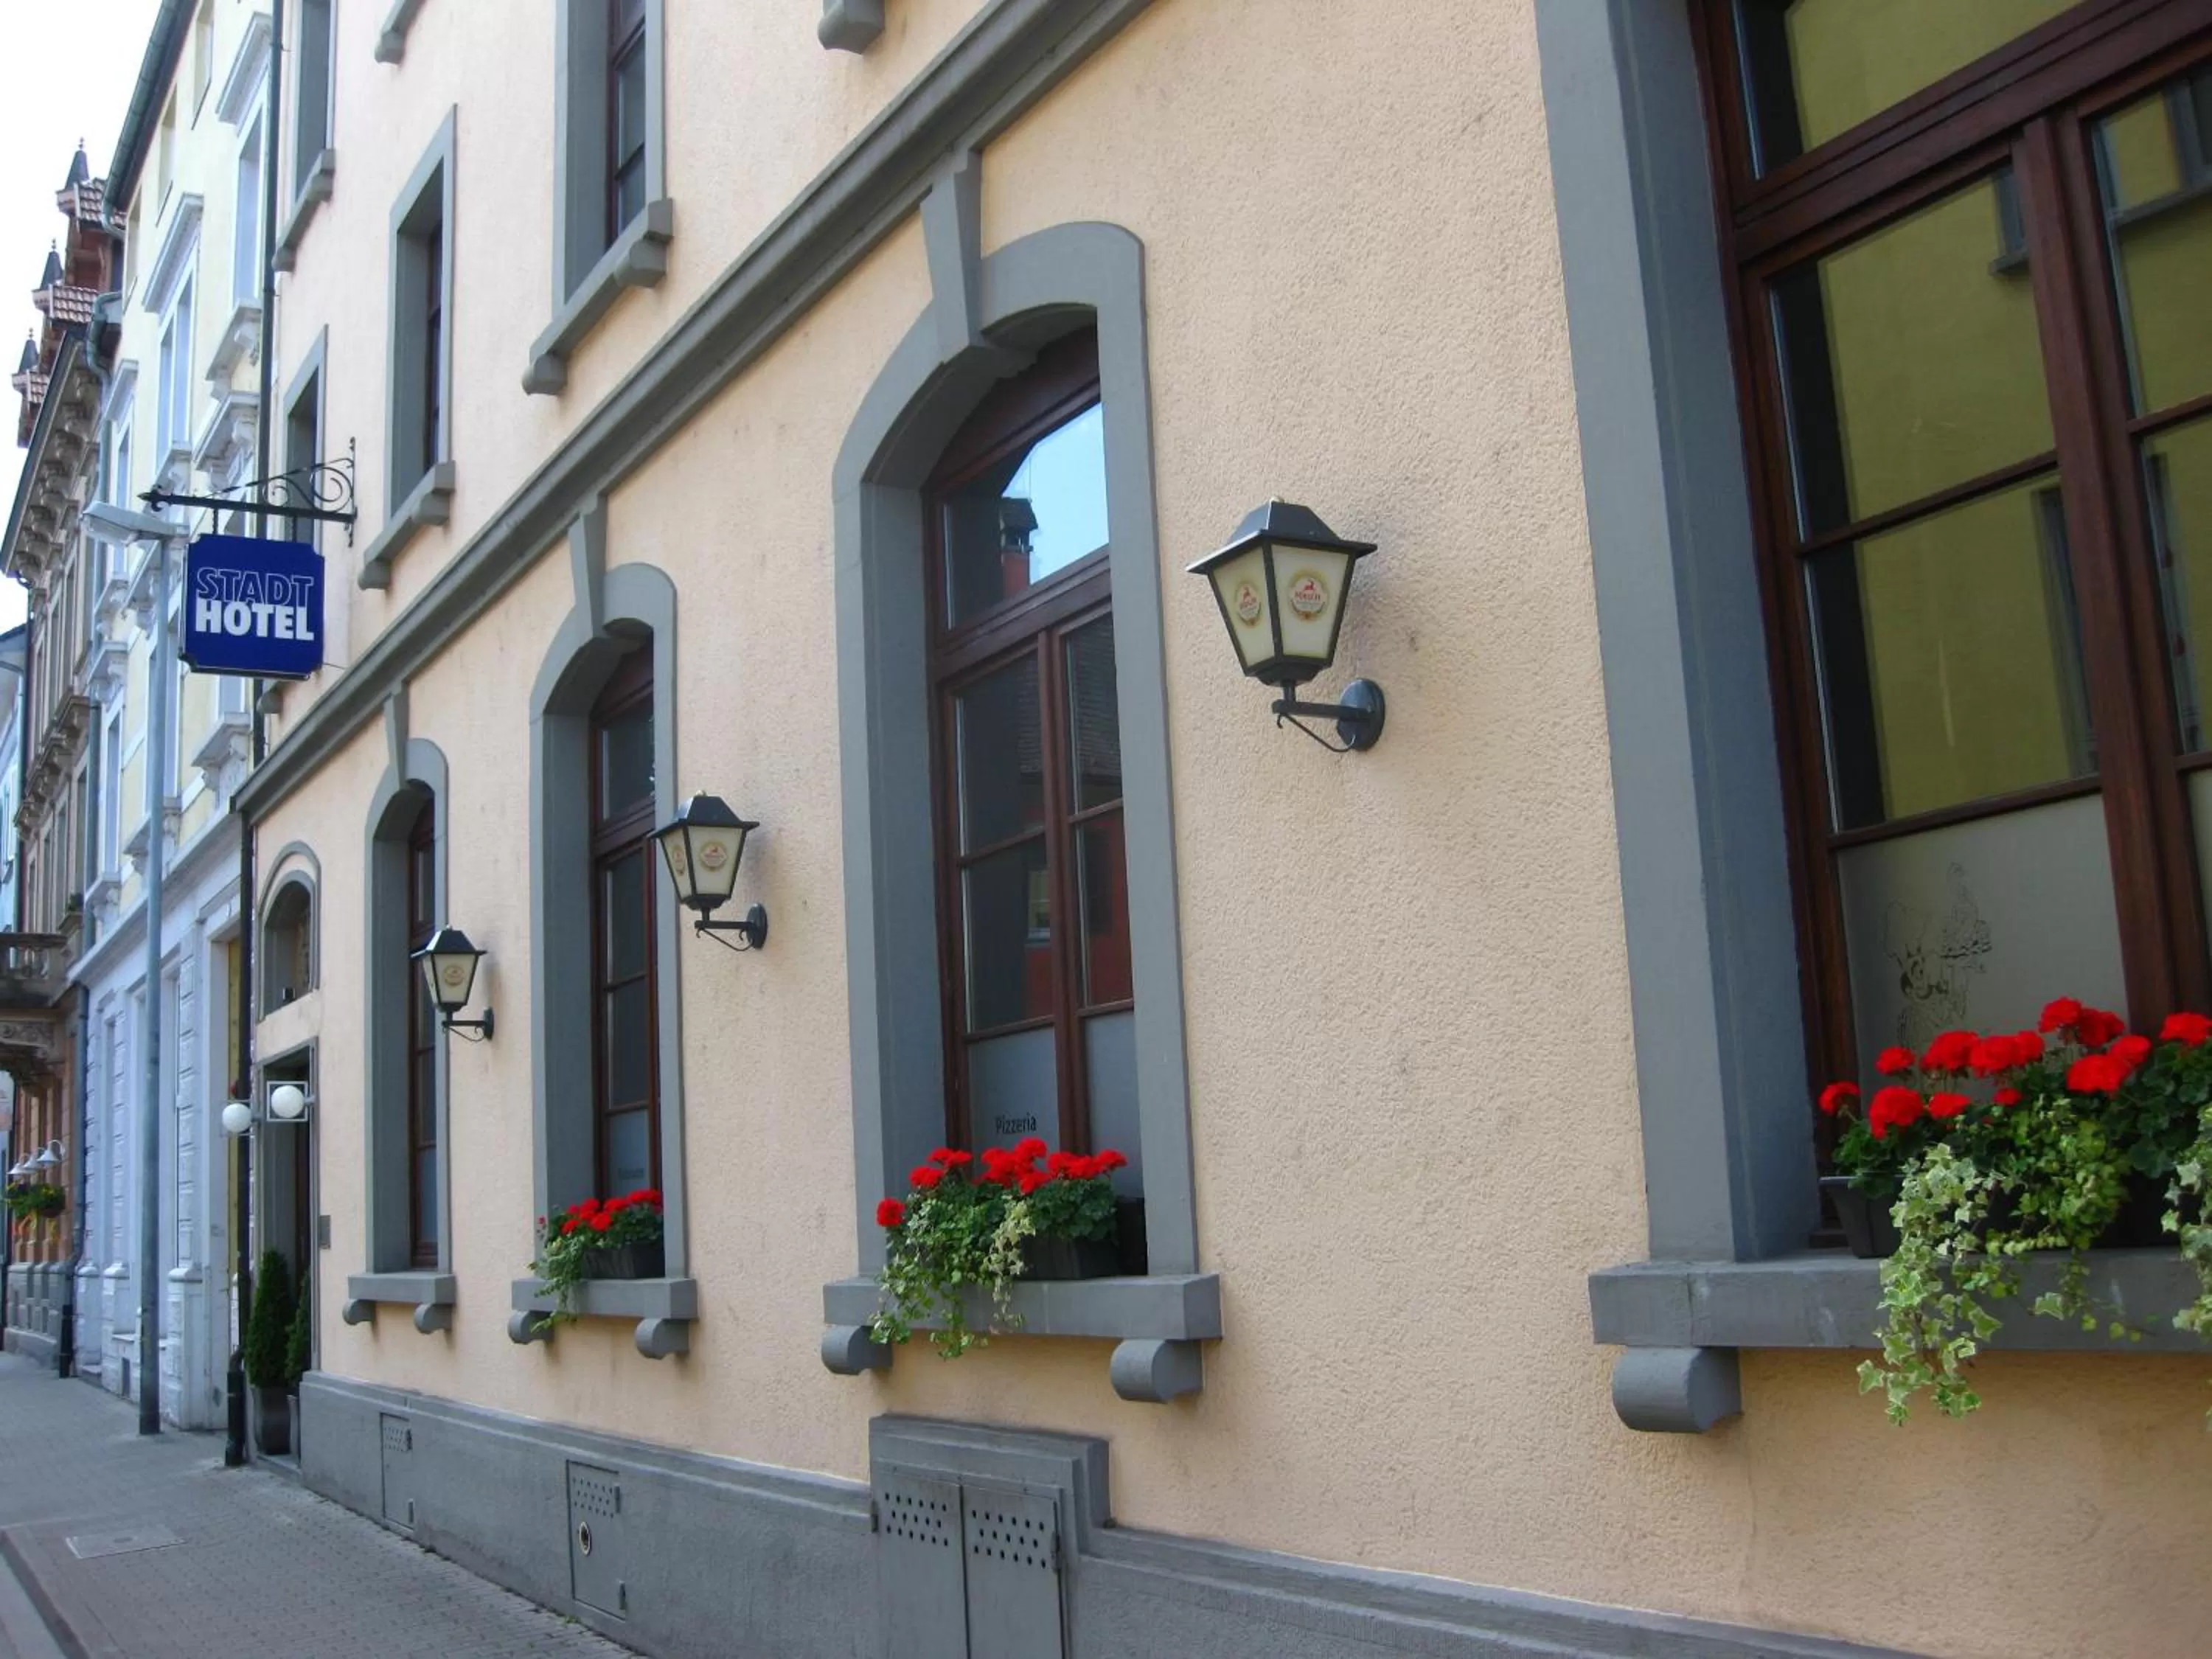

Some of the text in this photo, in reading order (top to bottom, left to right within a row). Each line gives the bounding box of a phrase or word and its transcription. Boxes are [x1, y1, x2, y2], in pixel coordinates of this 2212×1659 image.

[196, 566, 314, 607] STADT
[195, 597, 314, 641] HOTEL
[995, 1112, 1037, 1133] Pizzeria
